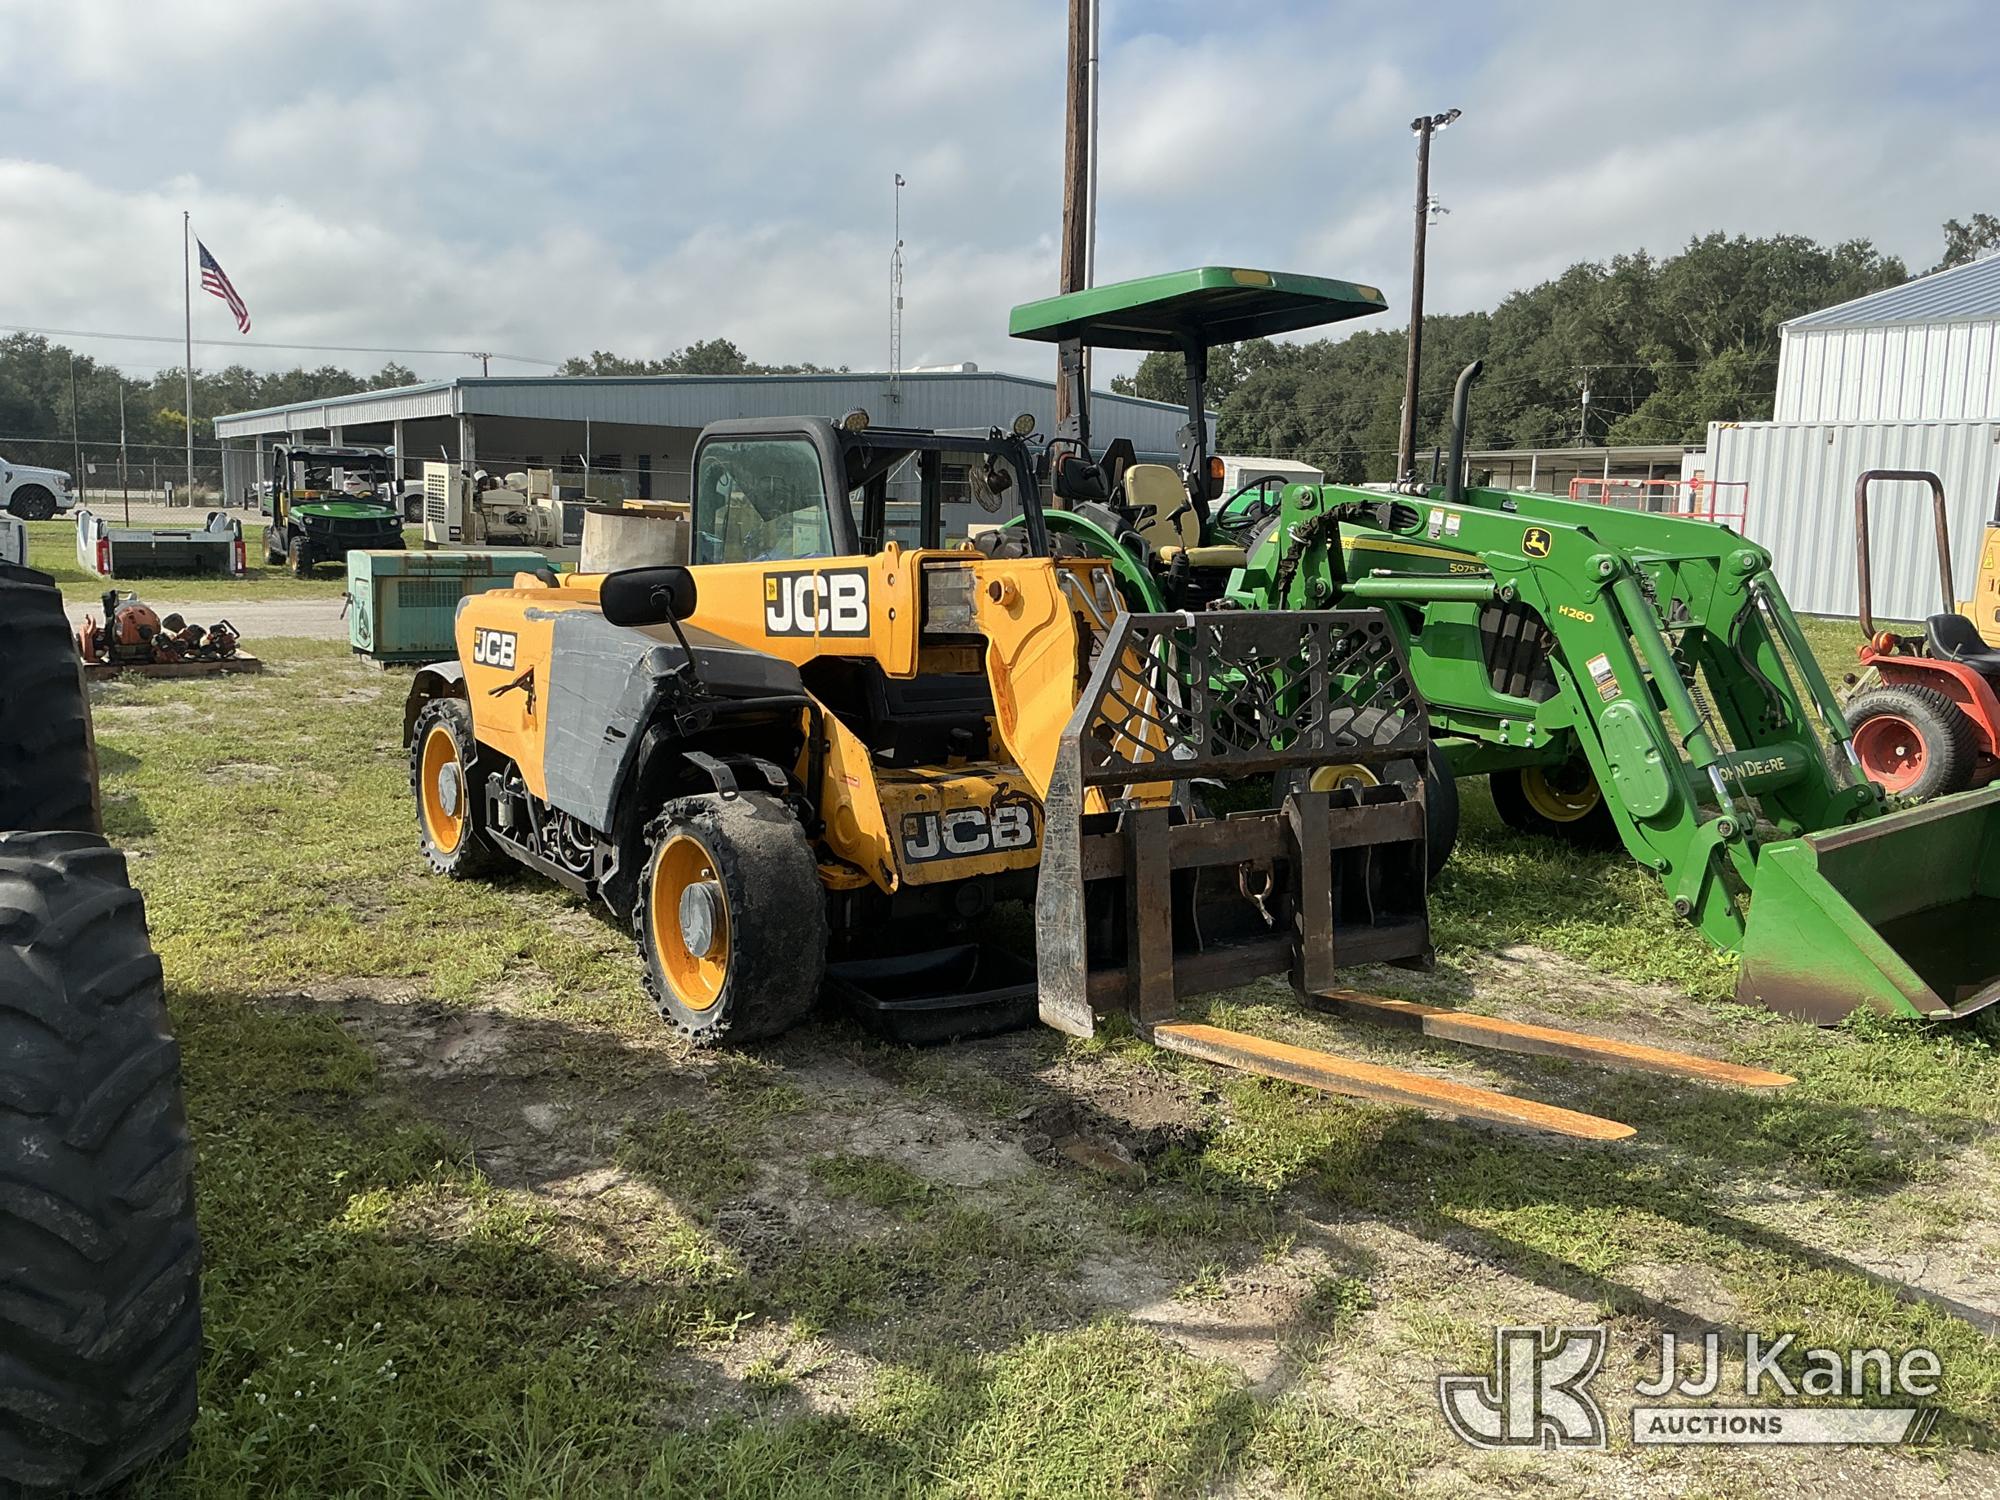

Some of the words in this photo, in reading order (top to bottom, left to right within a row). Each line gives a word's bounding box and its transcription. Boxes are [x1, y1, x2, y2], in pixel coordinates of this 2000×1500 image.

[767, 574, 867, 632] JCB
[1558, 605, 1595, 623] H260
[474, 630, 516, 667] JCB
[1719, 765, 1746, 781] OHN
[1744, 757, 1786, 777] DEERE
[906, 806, 1032, 858] JCB
